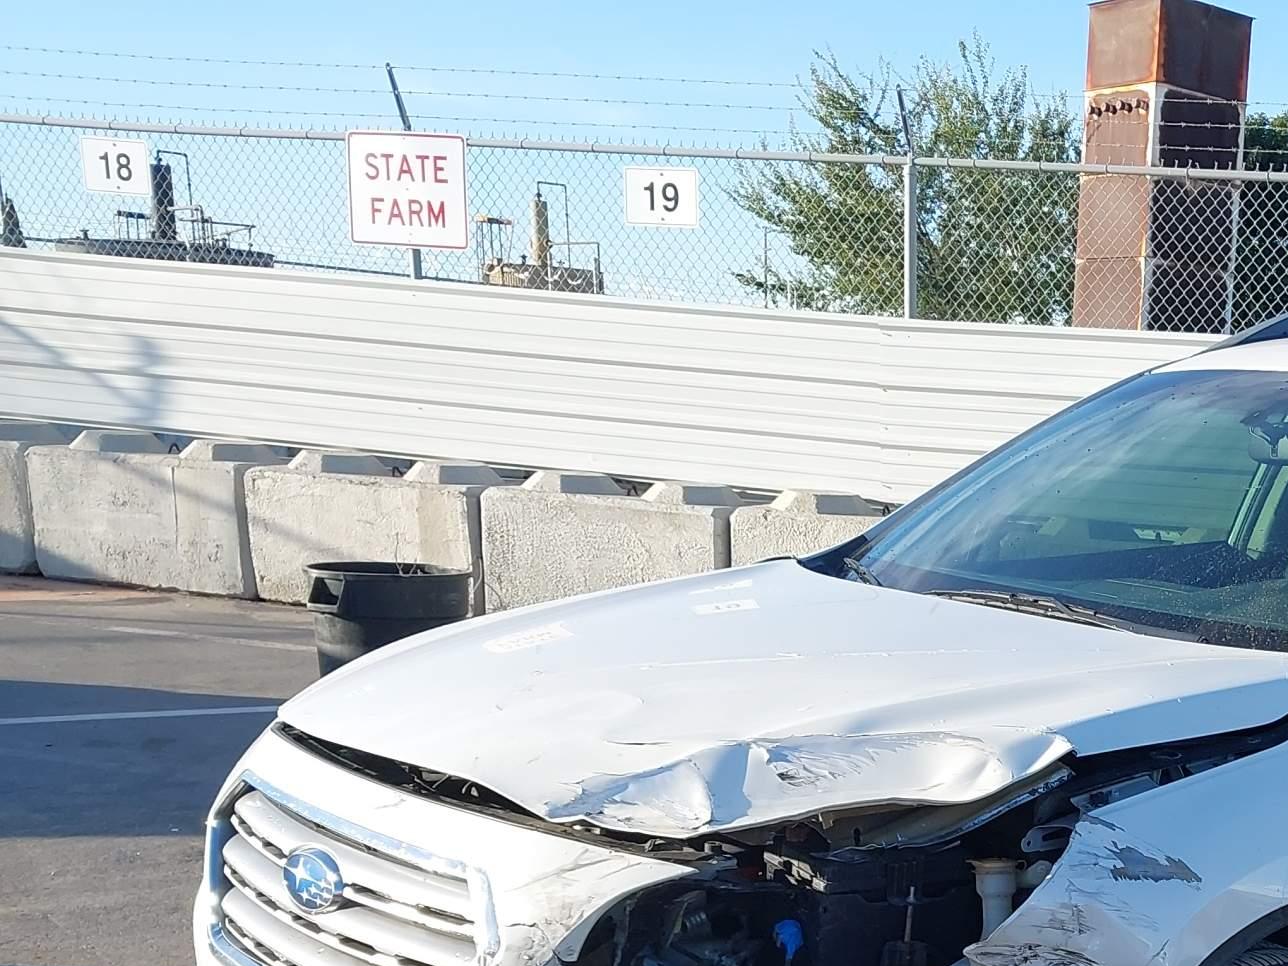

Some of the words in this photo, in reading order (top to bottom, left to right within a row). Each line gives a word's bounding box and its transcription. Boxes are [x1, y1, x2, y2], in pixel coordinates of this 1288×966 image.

[99, 151, 132, 182] 18
[364, 152, 449, 184] STATE
[370, 197, 446, 229] FARM
[643, 182, 679, 213] 19
